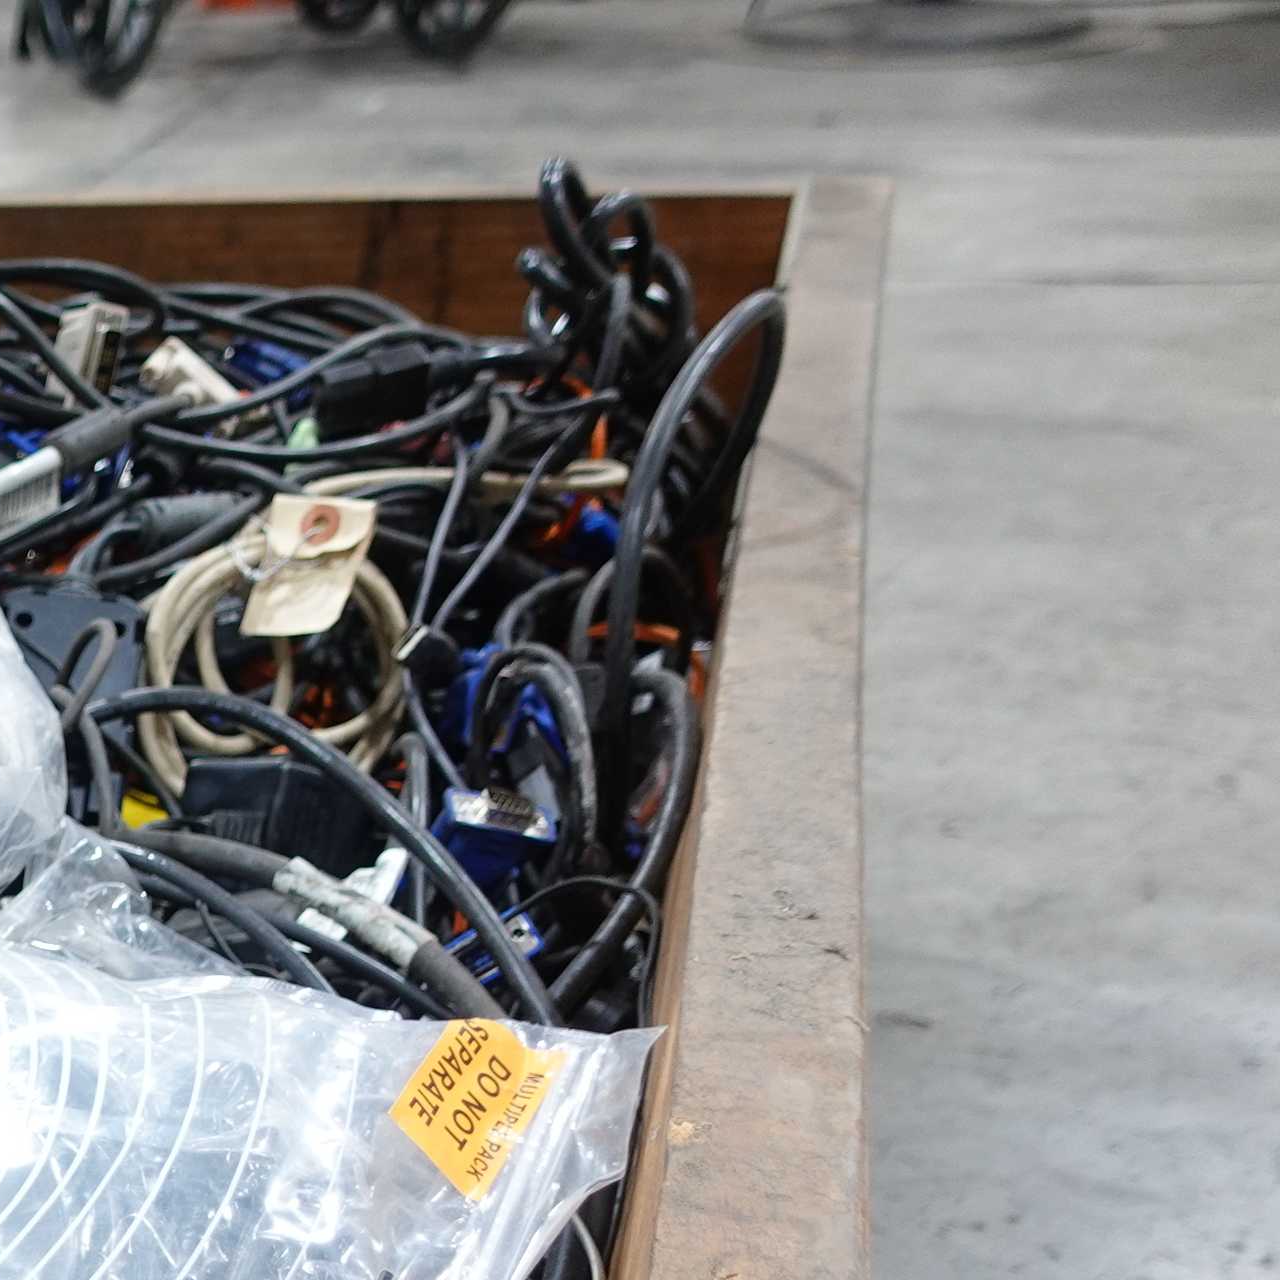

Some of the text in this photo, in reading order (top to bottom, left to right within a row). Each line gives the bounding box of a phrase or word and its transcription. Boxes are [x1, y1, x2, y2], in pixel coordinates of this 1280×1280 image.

[408, 1017, 490, 1127] SEPARATE
[444, 1054, 512, 1152] DO NOT
[466, 1138, 502, 1182] PACK
